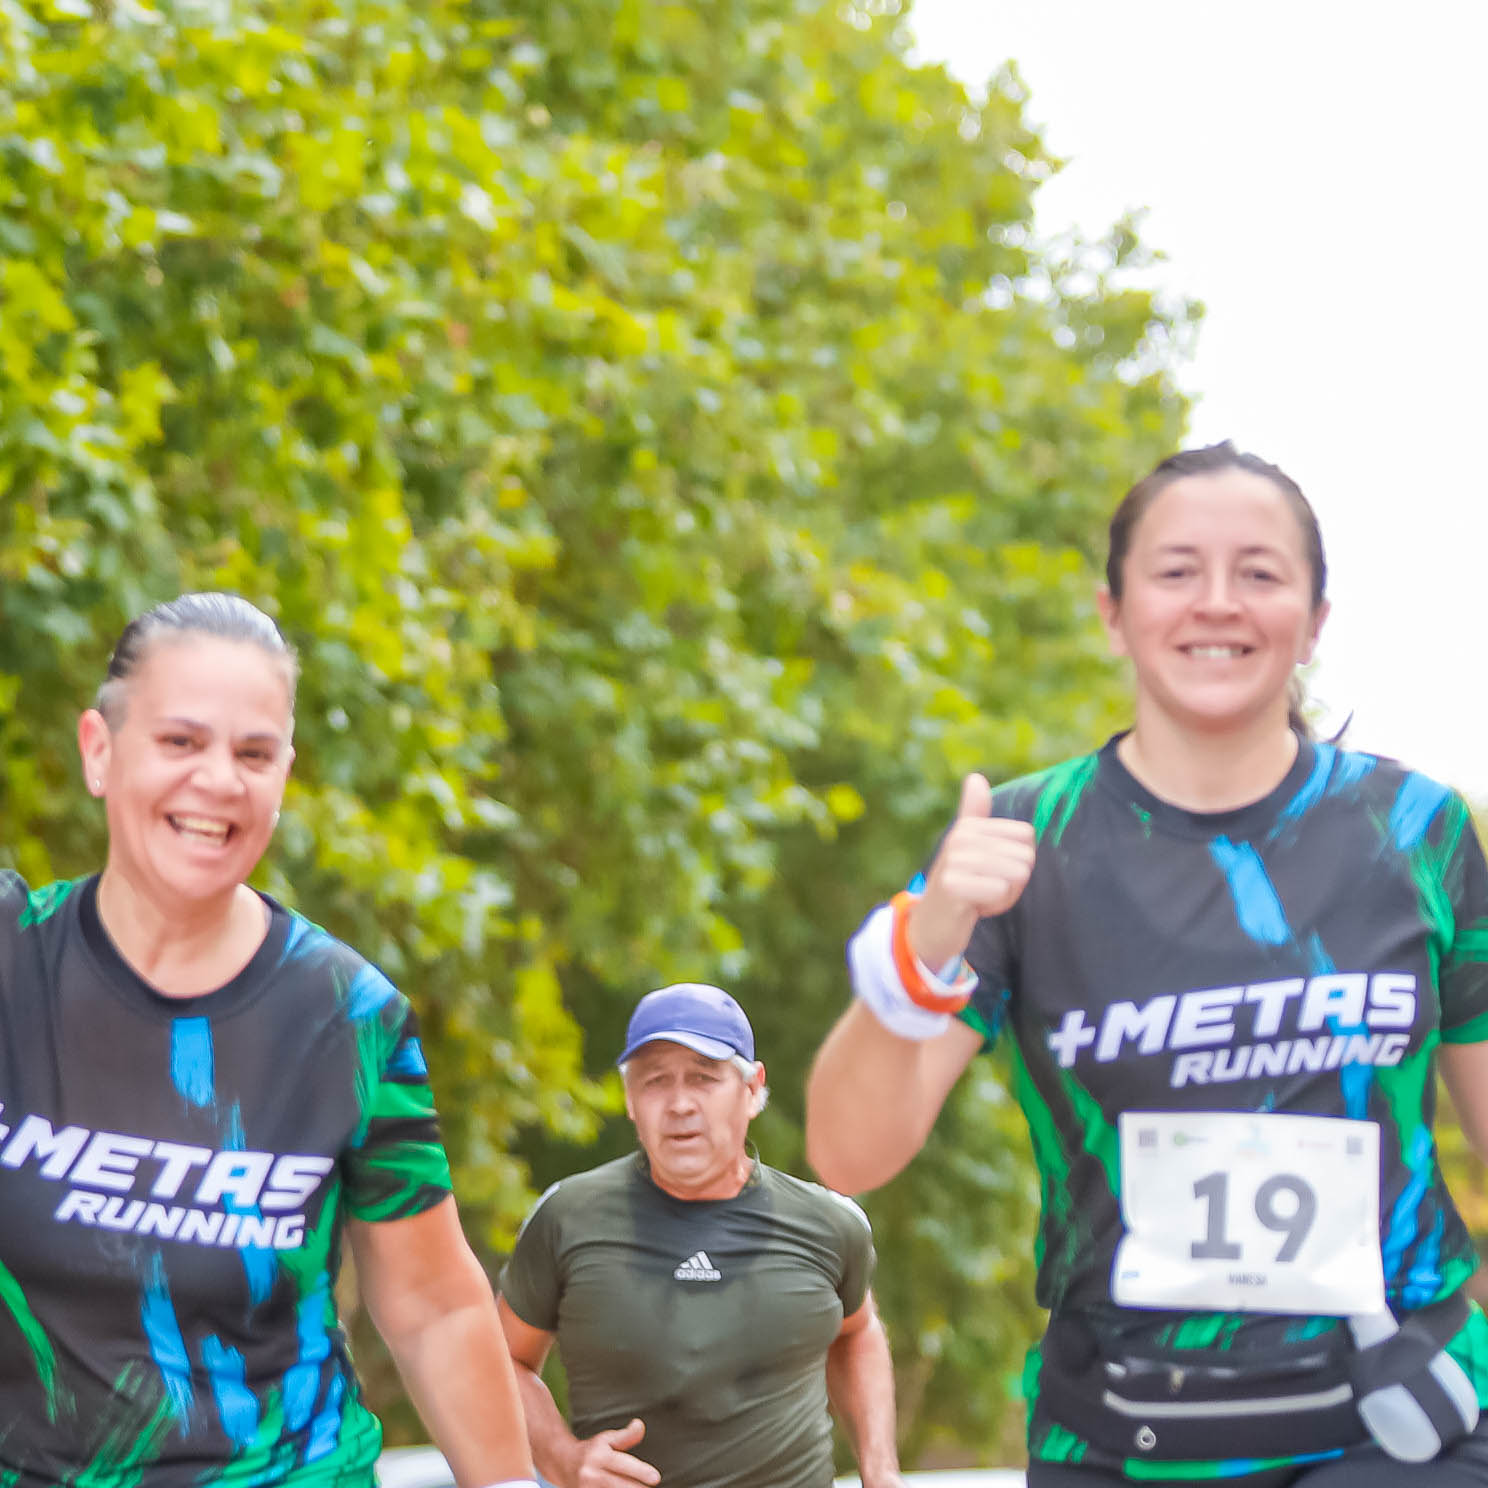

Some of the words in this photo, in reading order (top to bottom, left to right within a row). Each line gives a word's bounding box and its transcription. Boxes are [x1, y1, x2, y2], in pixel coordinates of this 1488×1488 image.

[1170, 1033, 1411, 1088] RUNNING
[55, 1189, 306, 1250] RUNNING
[1189, 1170, 1319, 1263] 19
